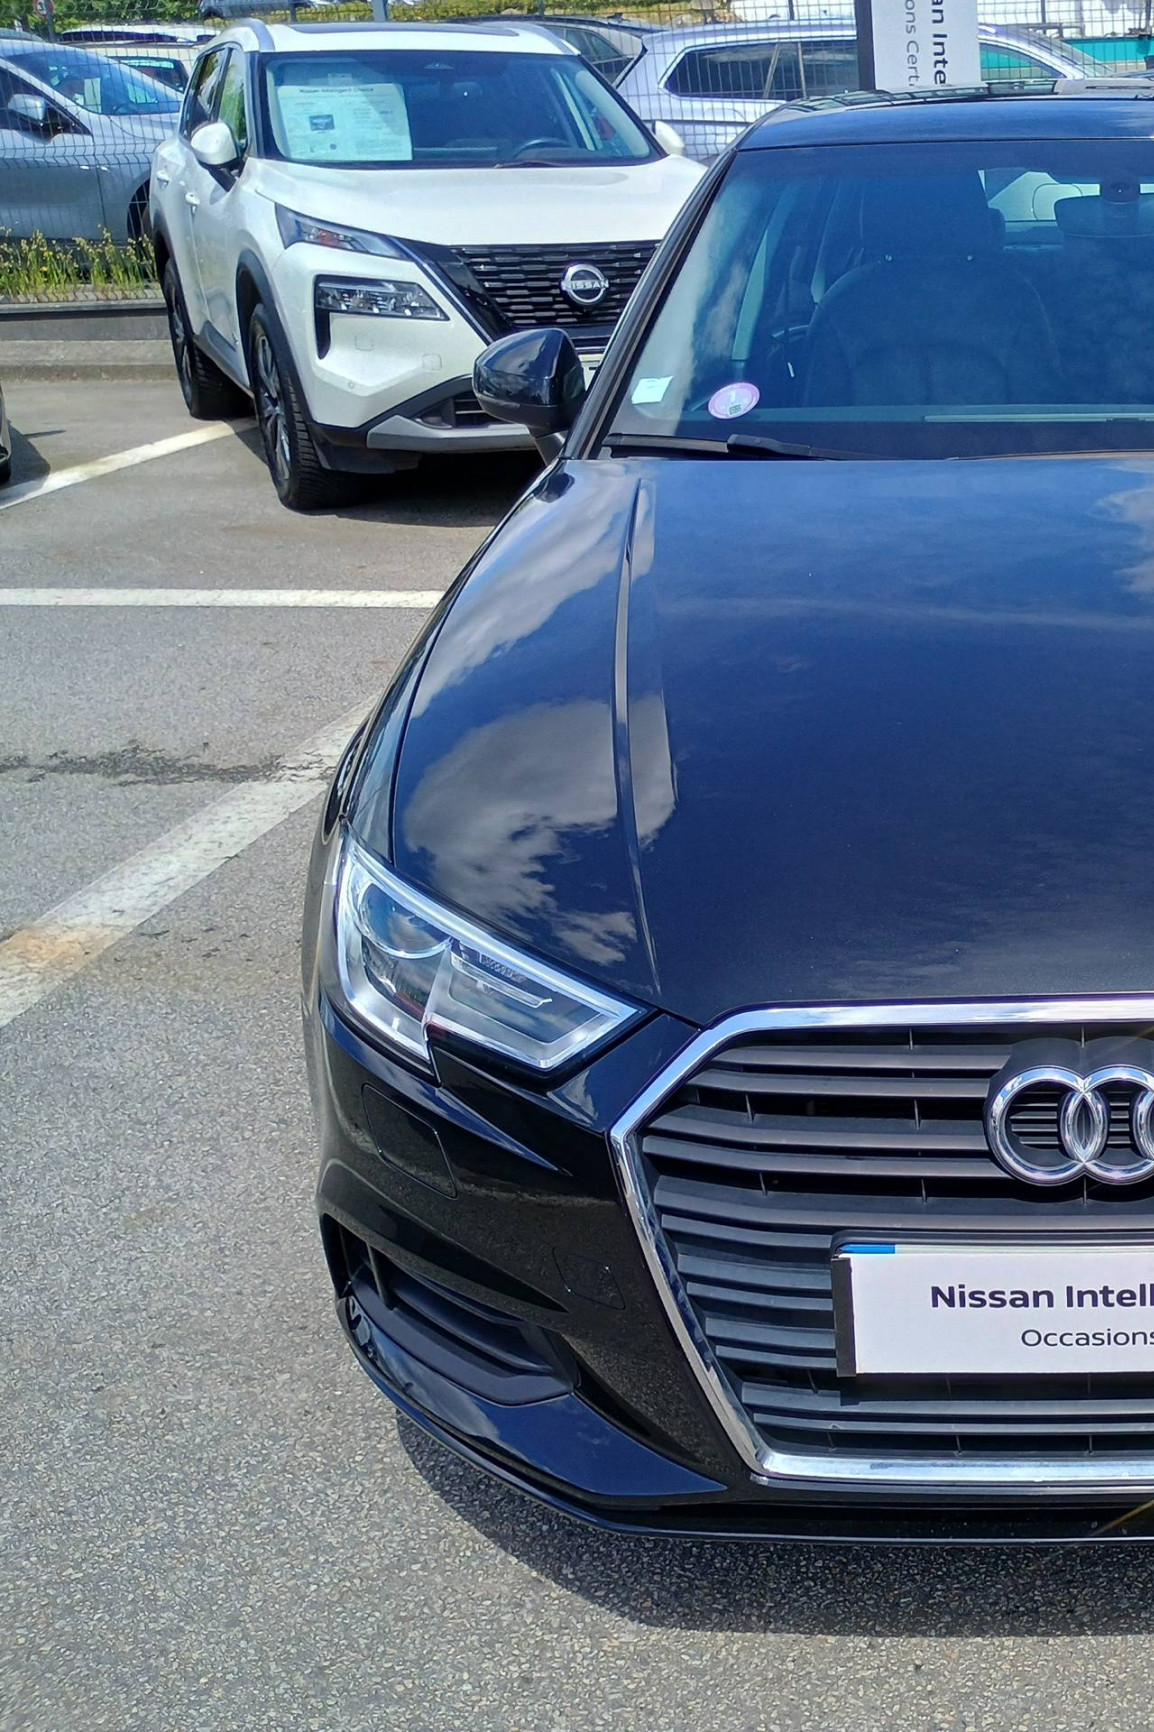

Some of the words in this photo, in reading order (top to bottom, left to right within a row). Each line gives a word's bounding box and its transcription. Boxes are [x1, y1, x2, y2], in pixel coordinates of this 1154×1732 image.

[932, 33, 949, 85] Inte
[561, 279, 609, 290] NISSAN
[930, 1283, 1055, 1309] Nissan
